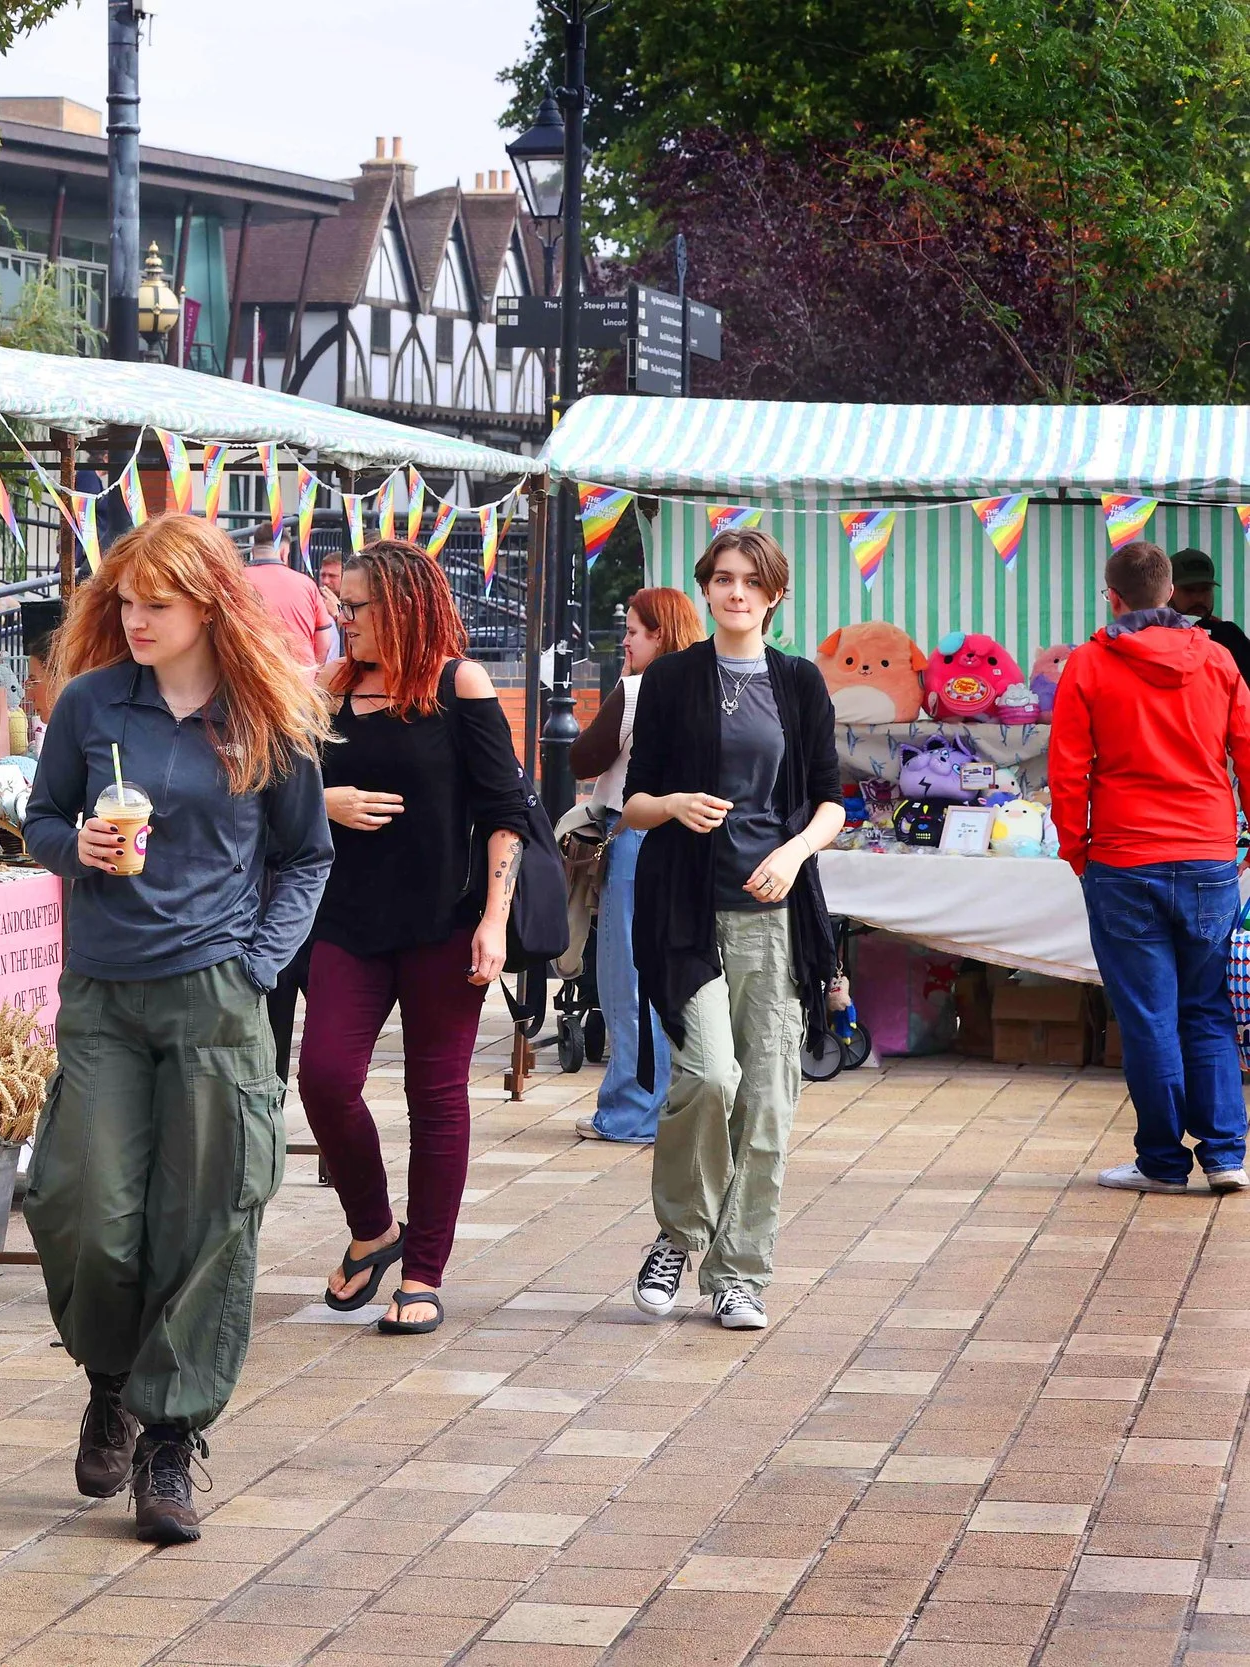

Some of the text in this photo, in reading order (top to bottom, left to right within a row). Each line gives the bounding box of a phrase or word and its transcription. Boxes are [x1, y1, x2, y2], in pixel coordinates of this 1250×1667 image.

[543, 301, 558, 309] The
[583, 301, 605, 311] Steep
[607, 301, 620, 309] Hill
[586, 495, 602, 504] THE
[1111, 503, 1126, 511] THE
[985, 508, 1000, 516] THE
[851, 522, 866, 530] THE
[10, 948, 28, 974] THE
[30, 942, 60, 970] HEART
[14, 985, 49, 1012] OF THE
